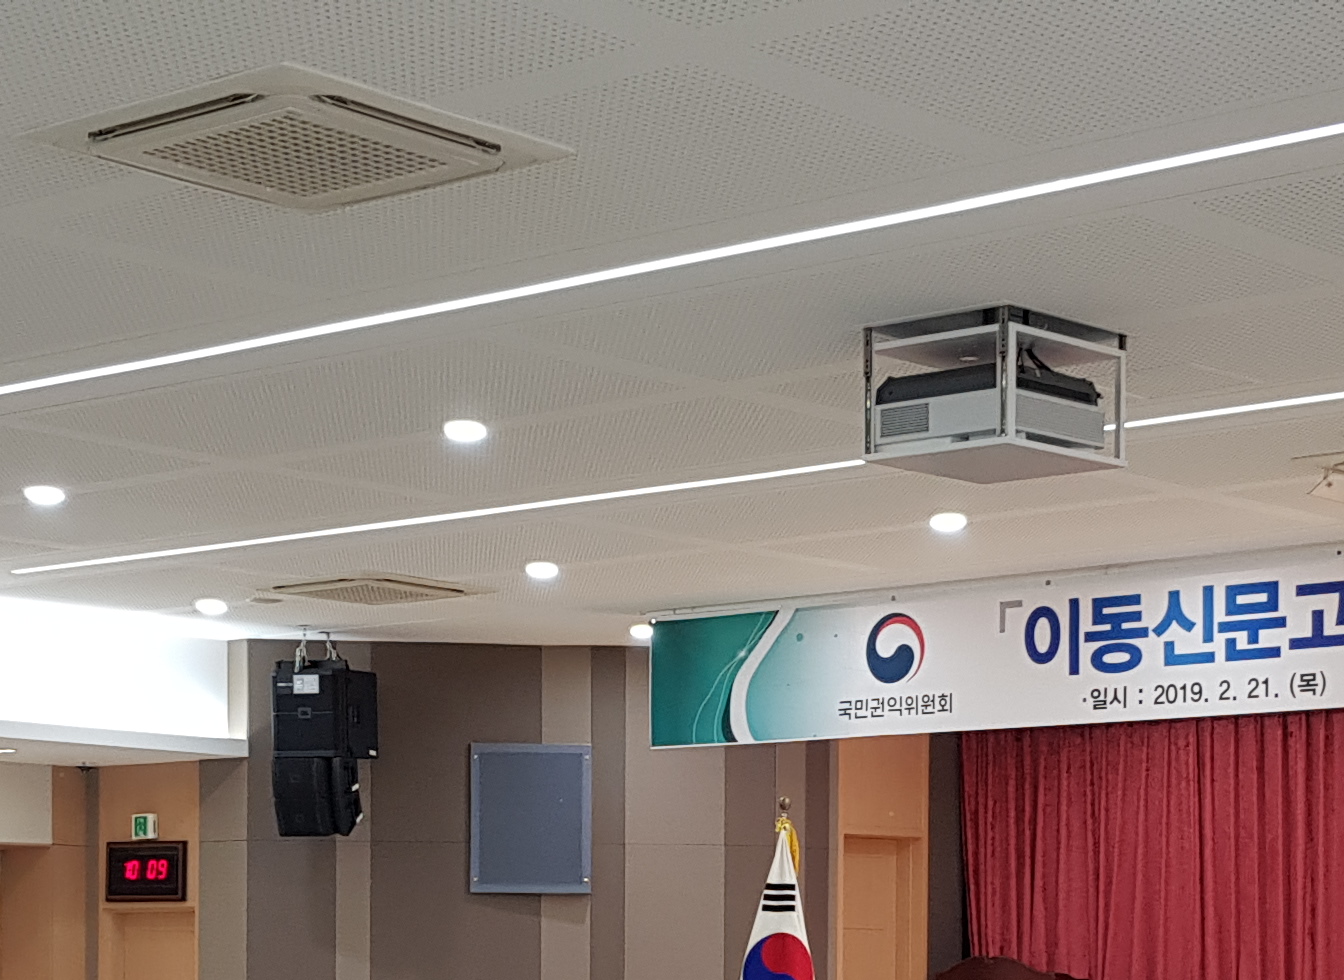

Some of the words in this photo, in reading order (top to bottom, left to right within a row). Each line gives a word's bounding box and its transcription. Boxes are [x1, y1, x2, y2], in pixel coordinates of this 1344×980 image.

[1153, 681, 1209, 706] 2019.
[1218, 679, 1237, 701] 2.
[1246, 677, 1280, 699] 21.
[1289, 670, 1327, 698] (목)
[837, 692, 953, 720] 국민권익위원회
